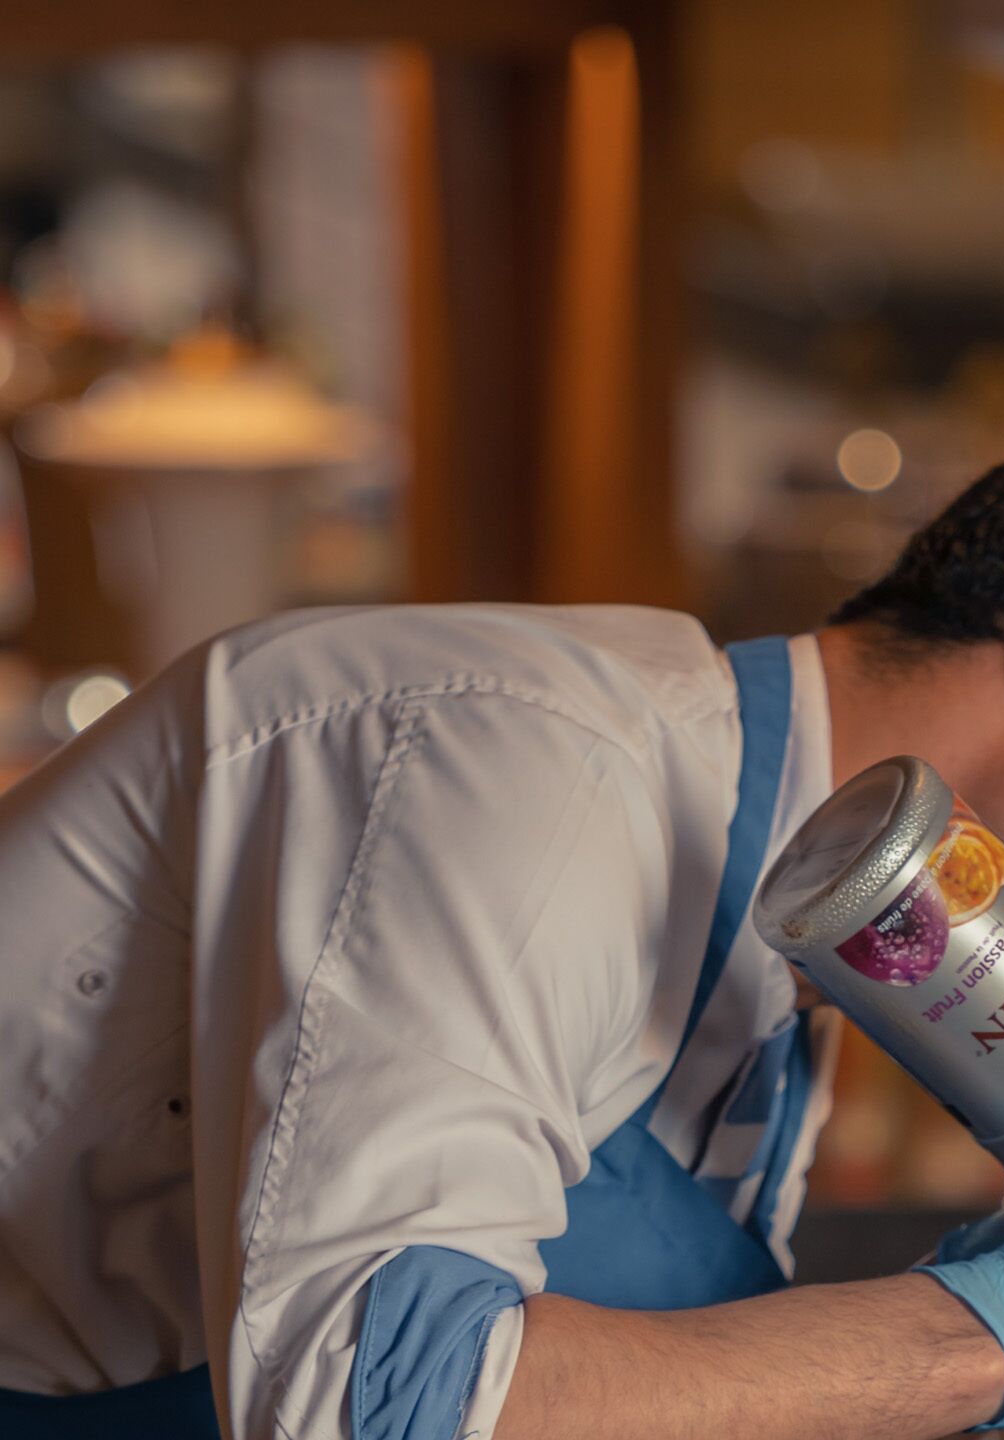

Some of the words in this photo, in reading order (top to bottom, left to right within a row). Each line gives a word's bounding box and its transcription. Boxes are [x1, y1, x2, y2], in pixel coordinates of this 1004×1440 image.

[900, 898, 913, 911] de
[877, 910, 902, 933] fruits
[922, 988, 967, 1023] Fruit
